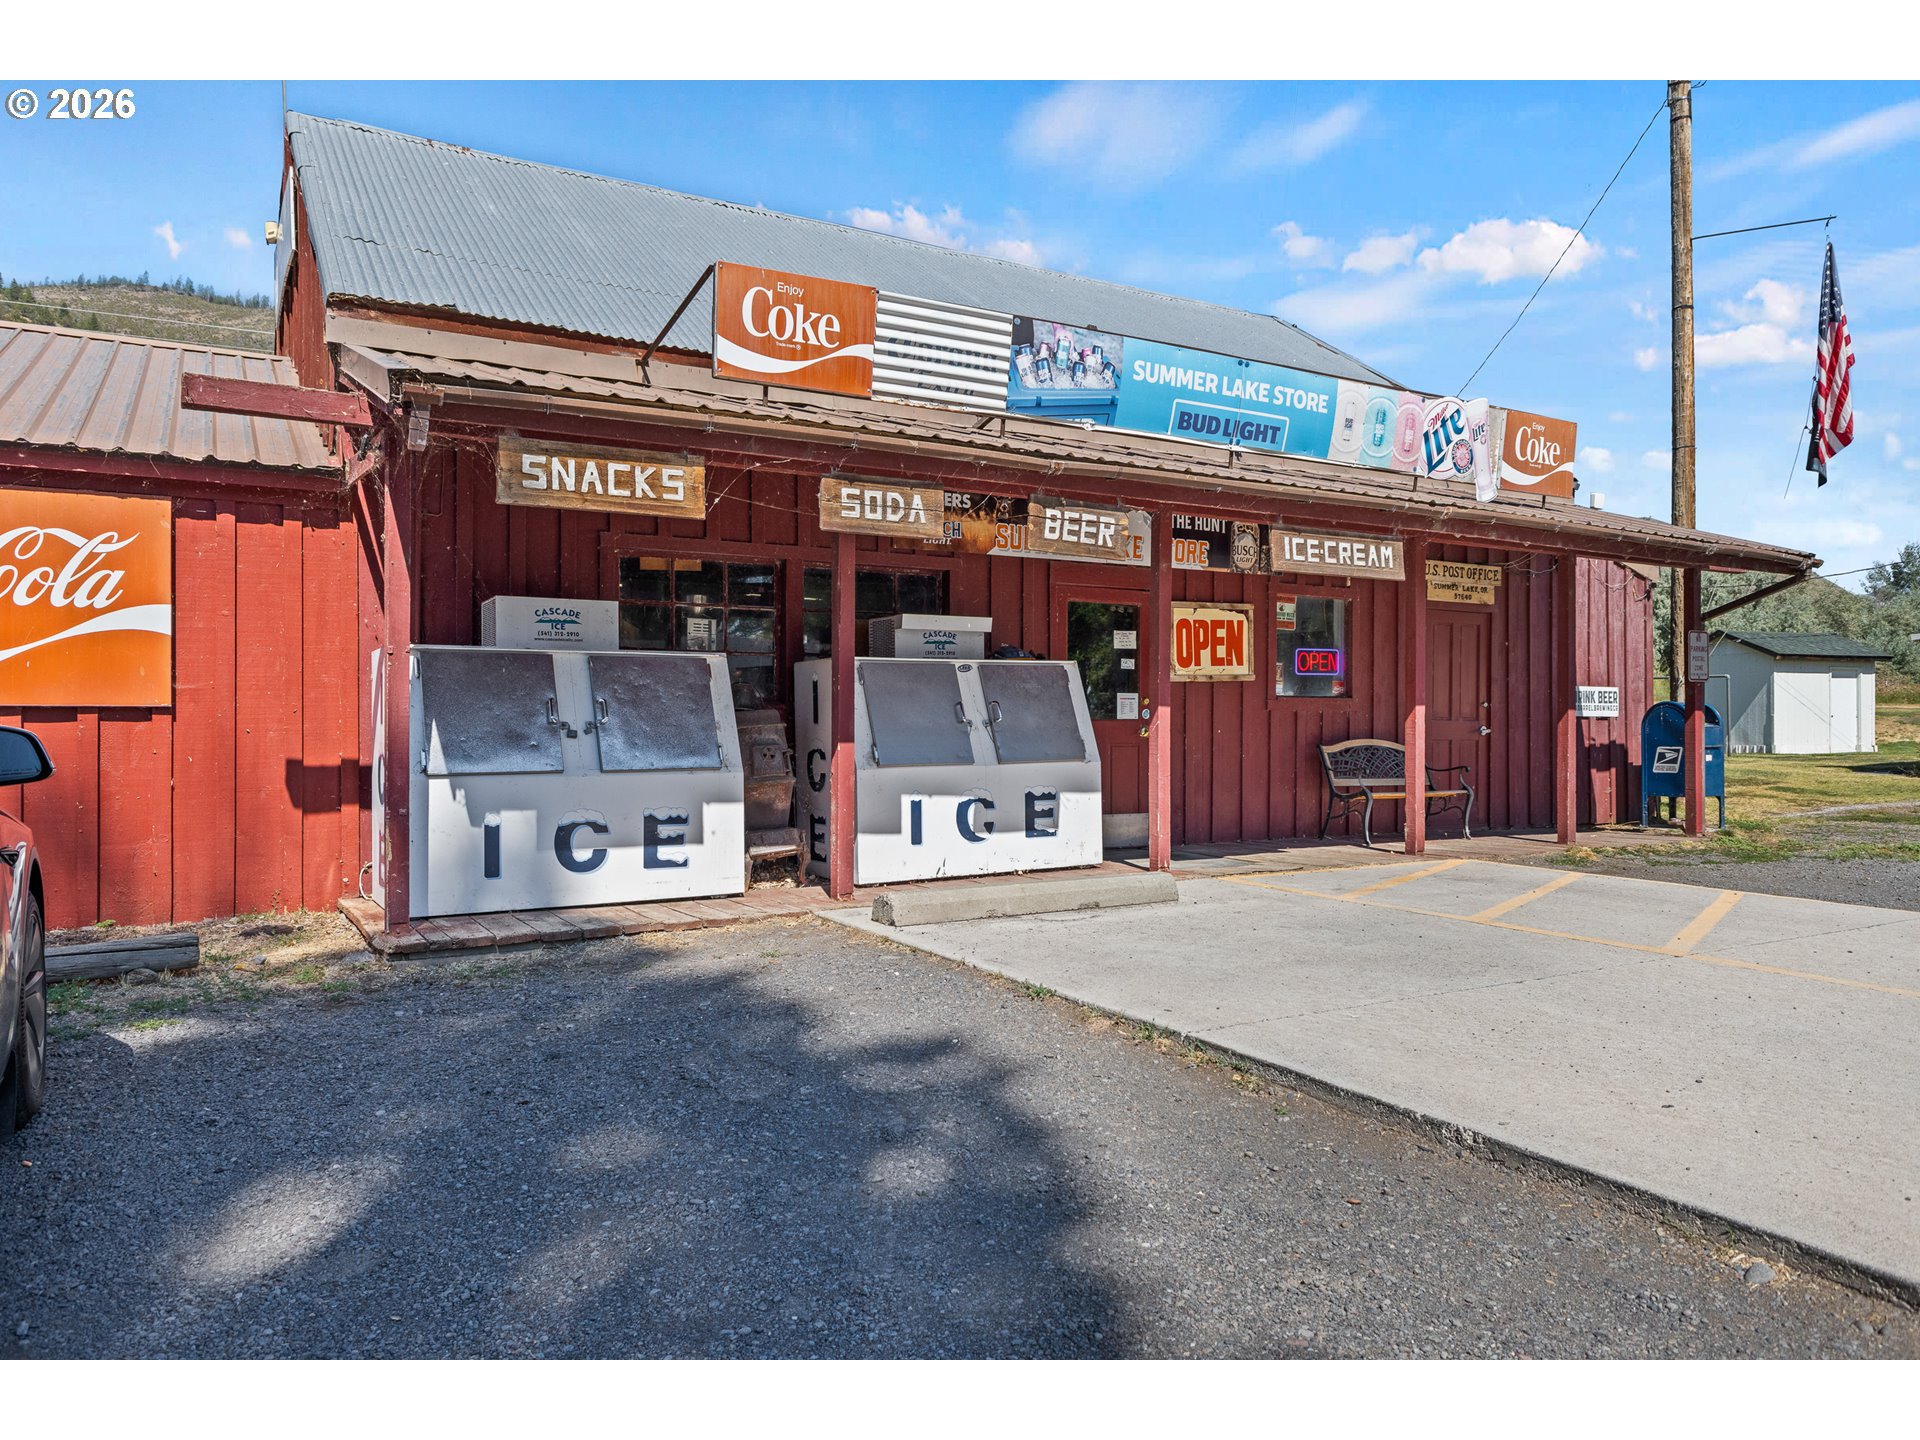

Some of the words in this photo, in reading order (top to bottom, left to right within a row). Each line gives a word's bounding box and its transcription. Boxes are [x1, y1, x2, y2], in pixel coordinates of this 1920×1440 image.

[777, 281, 804, 297] Enjoy
[742, 286, 841, 349] Coke
[1132, 359, 1218, 394] SUMMER
[1222, 376, 1270, 403] LAKE
[1272, 385, 1329, 414] STORE
[1177, 411, 1221, 435] BUD
[1222, 418, 1281, 444] LIGHT
[1423, 408, 1465, 476] Lite
[1472, 422, 1486, 442] Lite
[1515, 426, 1560, 467] Coke
[522, 453, 685, 501] SNACKS
[840, 487, 926, 524] SODA
[1044, 508, 1116, 547] BEER
[1194, 516, 1228, 534] HUNT
[1172, 538, 1209, 567] ORE
[1231, 544, 1258, 556] BUSCH
[1434, 582, 1459, 591] SUMMER
[1443, 565, 1465, 578] POST
[1466, 568, 1499, 581] OFFICE
[534, 607, 581, 619] CASCADE
[922, 631, 957, 640] CASCADE
[1176, 618, 1244, 668] OPEN
[1297, 651, 1338, 672] OPEN
[1576, 691, 1596, 703] RINK
[1598, 691, 1618, 703] BEER
[806, 673, 827, 863] ICE
[910, 786, 1059, 846] ICE
[484, 803, 690, 880] ICE
